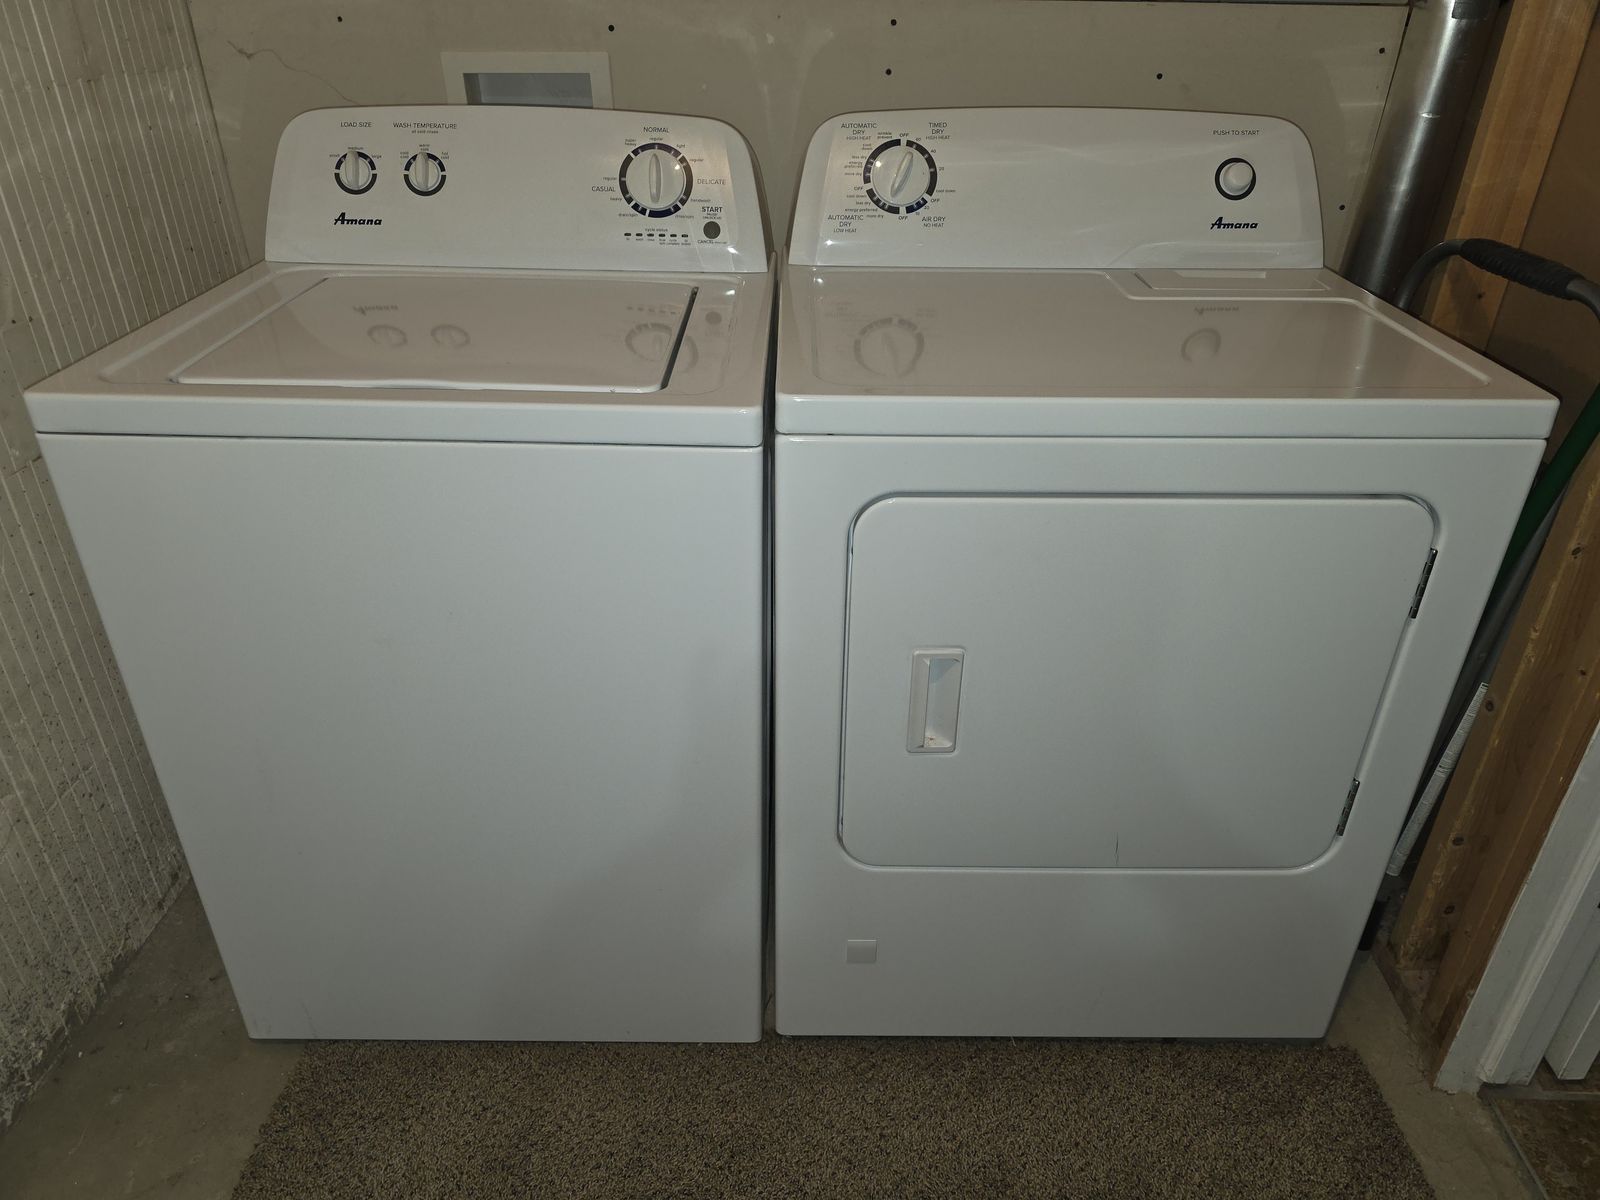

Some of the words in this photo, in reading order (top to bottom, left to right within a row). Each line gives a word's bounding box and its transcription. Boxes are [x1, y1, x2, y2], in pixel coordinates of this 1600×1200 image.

[413, 122, 457, 130] TEMPERATURE
[334, 211, 383, 226] Amana
[1210, 216, 1259, 230] Amana
